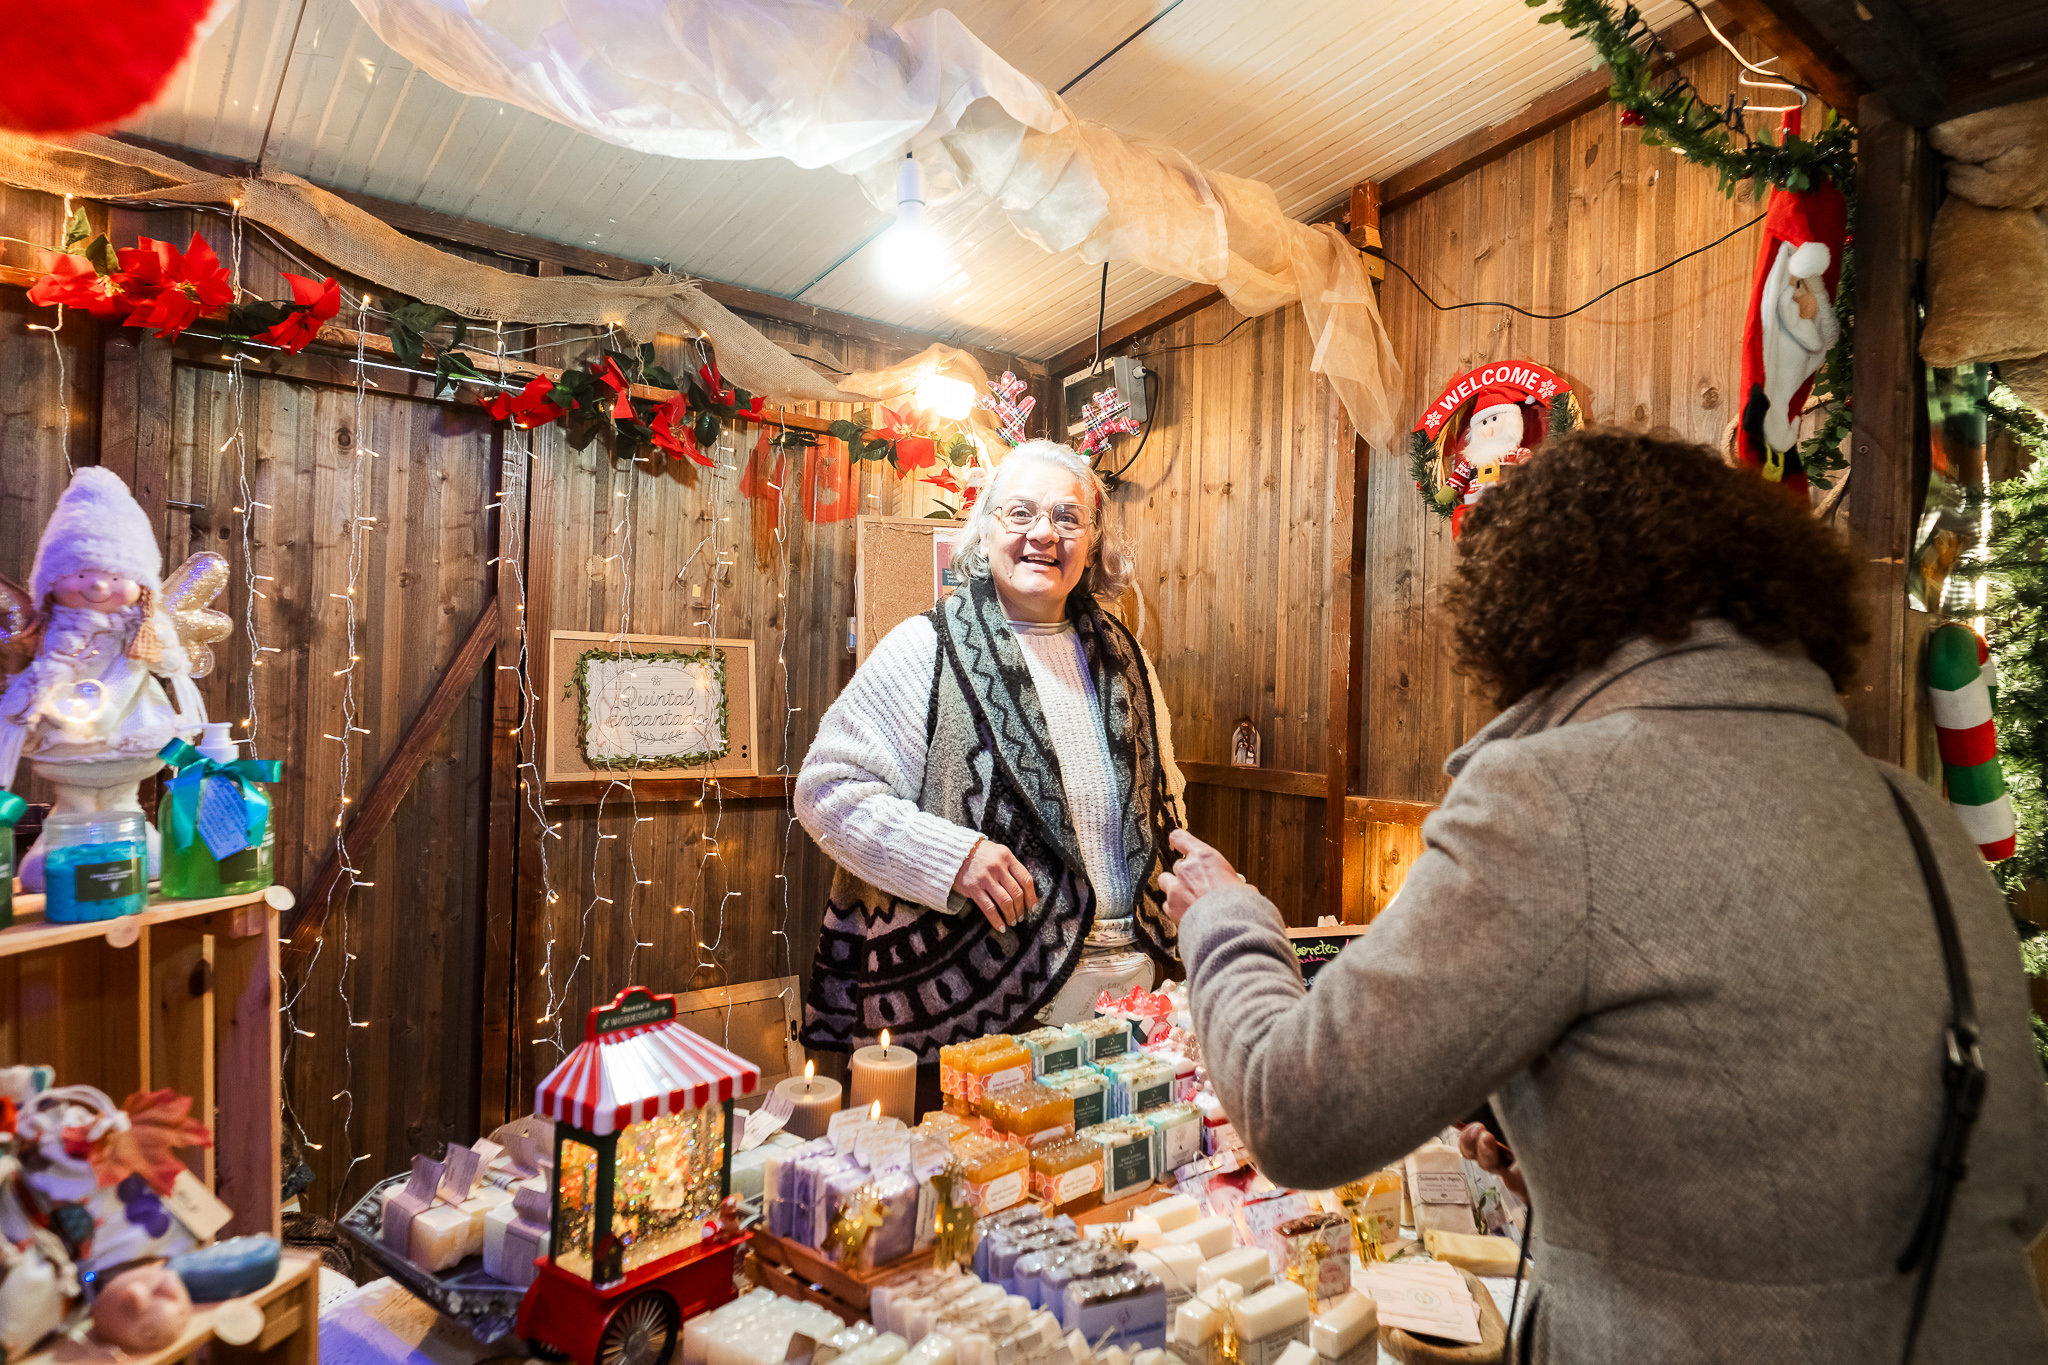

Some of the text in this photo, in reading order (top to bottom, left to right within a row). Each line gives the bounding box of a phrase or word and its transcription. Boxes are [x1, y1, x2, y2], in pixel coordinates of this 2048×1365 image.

[1439, 366, 1540, 410] WELCOME
[620, 686, 695, 709] Quintal
[605, 706, 708, 728] Encantado
[1292, 940, 1340, 957] bonetes
[610, 1009, 660, 1026] WORKSHOP
